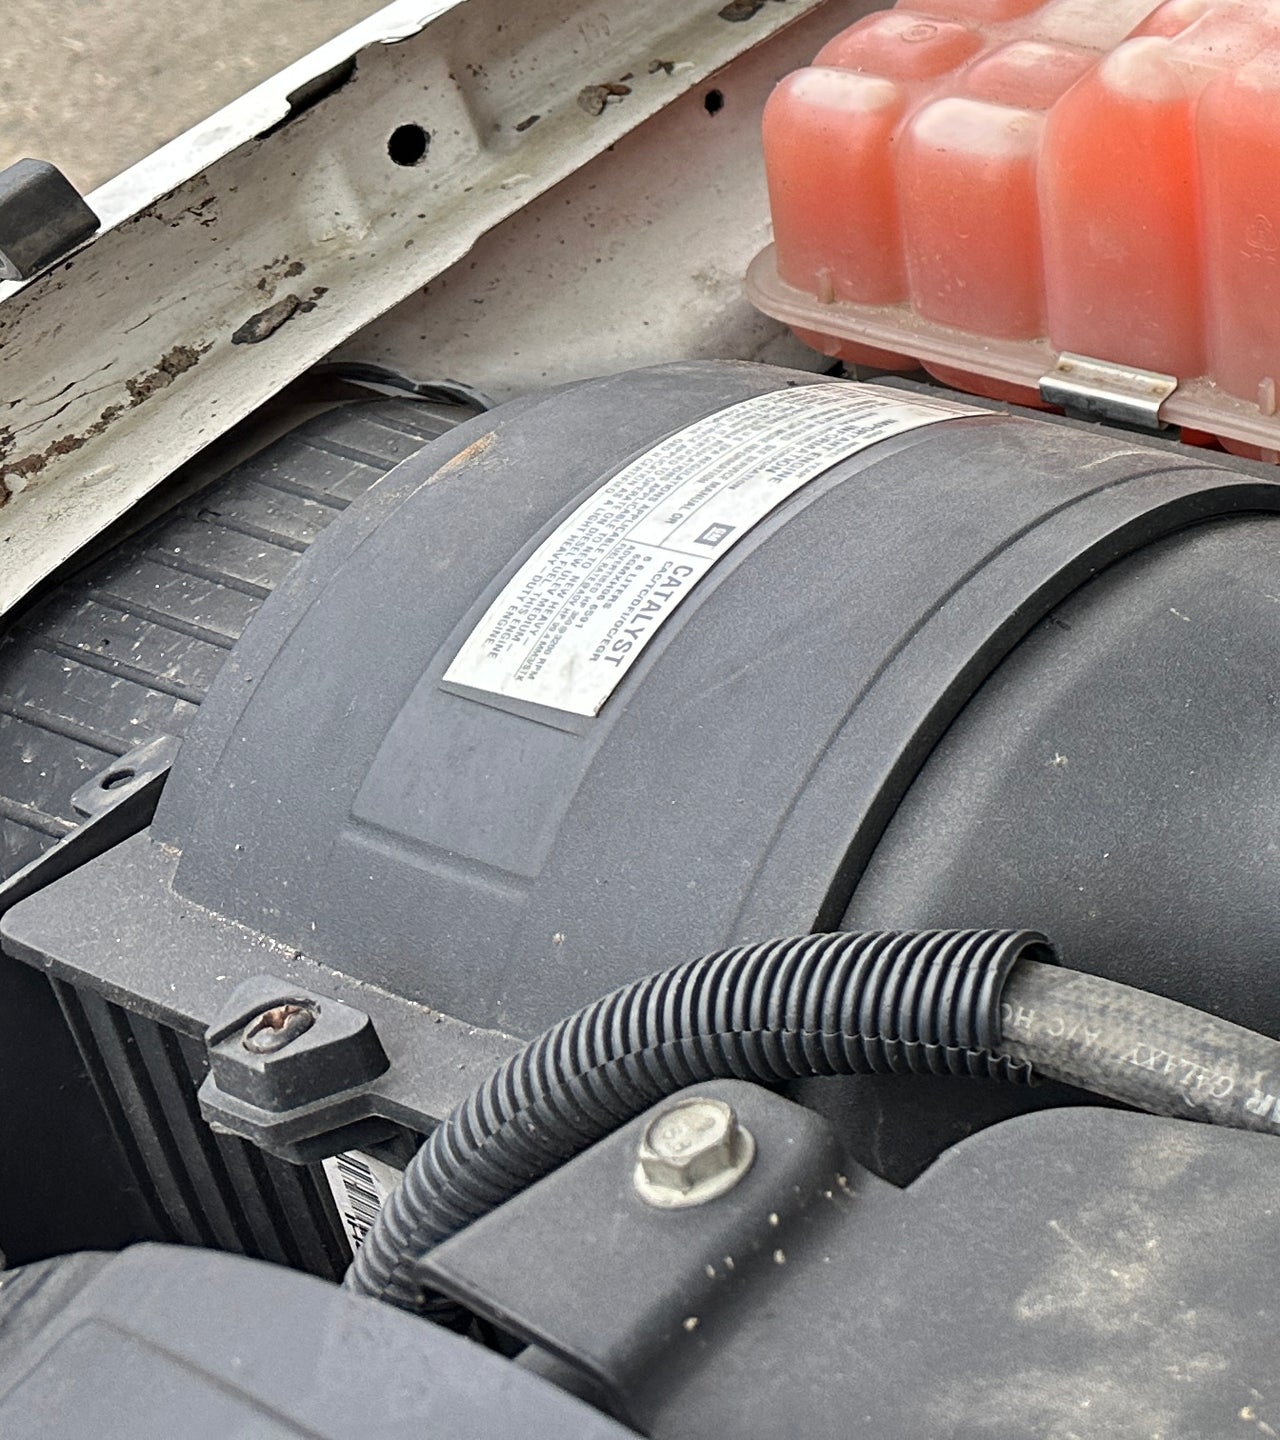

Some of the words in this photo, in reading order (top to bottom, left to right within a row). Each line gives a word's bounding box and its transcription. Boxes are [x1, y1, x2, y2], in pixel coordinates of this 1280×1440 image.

[765, 424, 858, 473] INFORMATION
[626, 443, 687, 486] APPLICATION
[647, 455, 712, 502] REGULATIONS
[769, 451, 822, 483] ENGINE
[605, 482, 660, 528] APPLICABLE
[611, 486, 628, 498] AS
[612, 476, 655, 509] OPERATE
[678, 480, 720, 510] MANUAL
[576, 506, 605, 532] LIGHT
[594, 503, 649, 553] APPLICABLE
[596, 511, 614, 525] ON
[664, 512, 683, 524] OR
[564, 526, 599, 556] DIESEL
[591, 531, 608, 543] TO
[569, 545, 594, 568] NEW
[580, 556, 597, 569] TO
[546, 569, 572, 596] ULEV
[556, 574, 580, 598] NEW
[602, 572, 636, 609] LITERS
[517, 592, 542, 615] THIS
[579, 595, 591, 608] HP
[605, 565, 692, 666] CATALYST
[511, 597, 549, 642] MEDIUM
[528, 600, 559, 636] HEAVY
[487, 617, 521, 658] ENGINE
[527, 657, 547, 680] RPM
[1045, 1014, 1101, 1049] A/C
[1118, 1039, 1238, 1101] GALAXY
